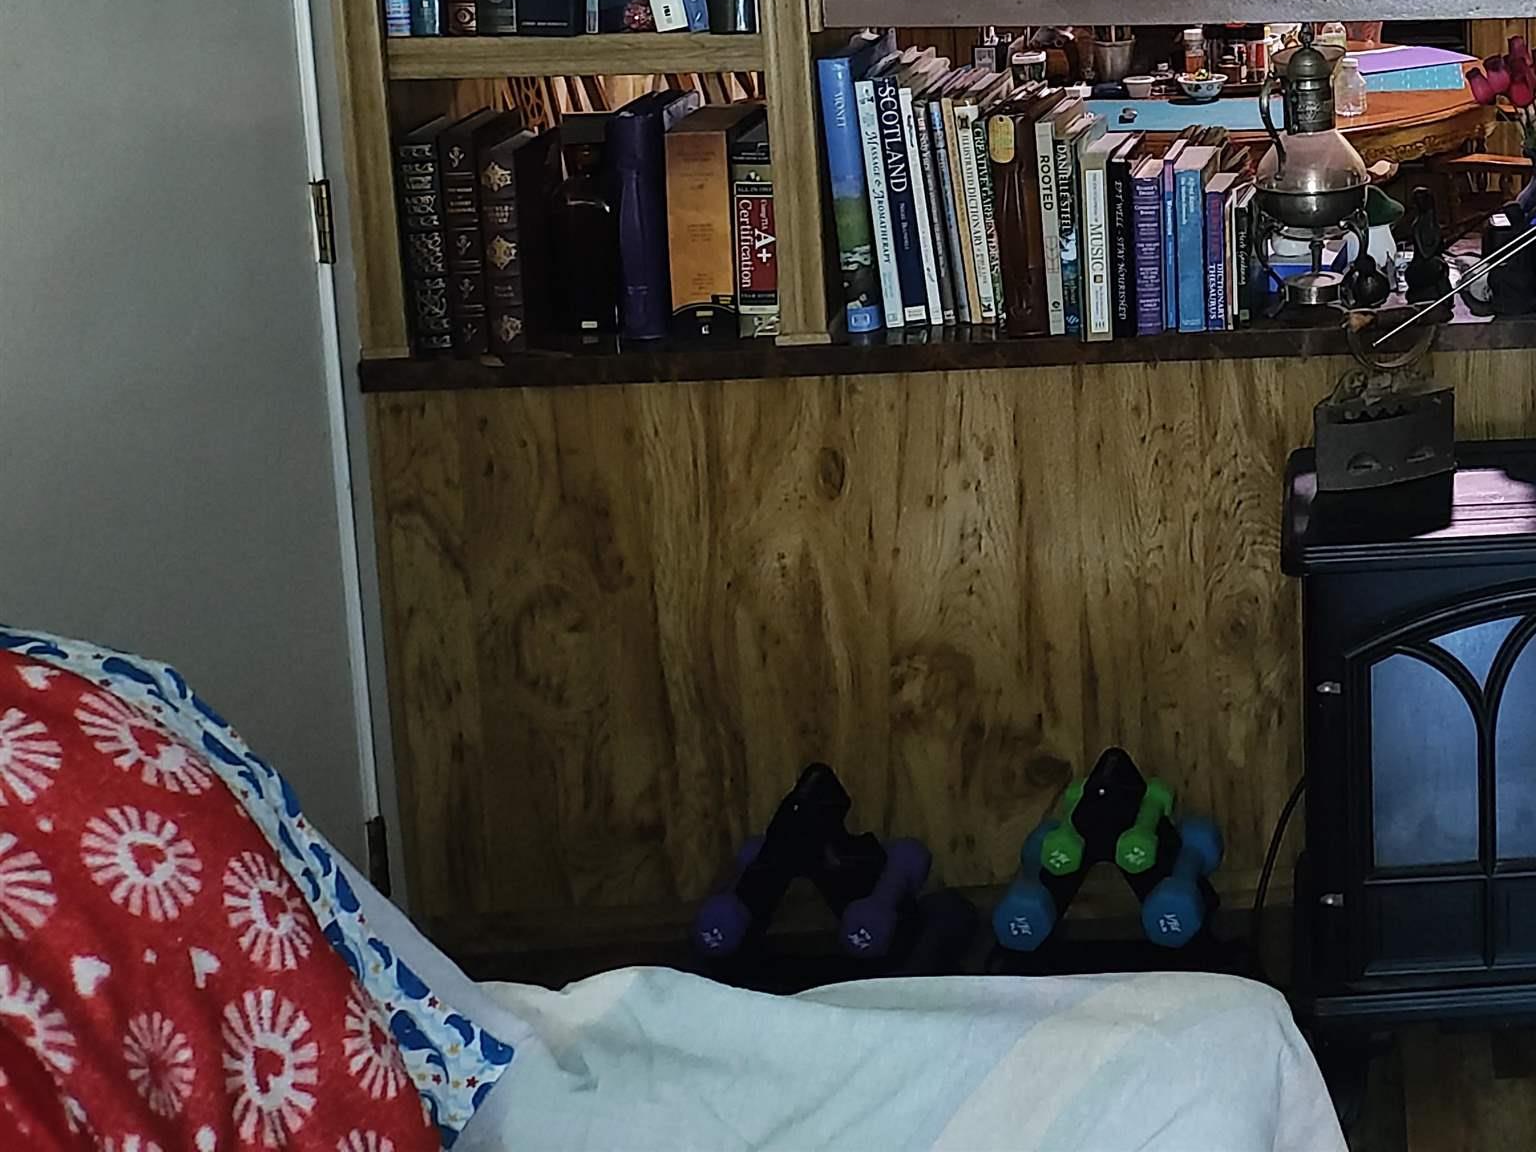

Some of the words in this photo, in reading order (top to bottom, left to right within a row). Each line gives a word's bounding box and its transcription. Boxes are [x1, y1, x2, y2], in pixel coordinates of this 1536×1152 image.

[834, 91, 846, 128] MONET
[865, 131, 880, 176] MASSAGE
[878, 86, 907, 193] SCOTLAND
[961, 134, 974, 186] ILLUSTRATED
[1040, 155, 1053, 211] ROOTED
[1056, 145, 1069, 198] DANIELLE
[759, 199, 768, 230] CompTIA
[872, 188, 891, 264] AROMATHERAPY
[967, 187, 982, 247] DICTIONARY
[973, 127, 987, 185] CREATIVE
[980, 187, 994, 235] GARDEN
[987, 238, 1000, 274] IDEAS
[1061, 200, 1072, 231] STEEL
[1115, 203, 1124, 228] WELL
[738, 200, 754, 288] Certification
[755, 229, 776, 263] A+
[1089, 223, 1104, 272] MUSIC
[1117, 237, 1125, 260] STAY
[1238, 251, 1247, 286] Gardening
[1117, 262, 1127, 320] NOURISHED
[1209, 263, 1217, 319] THESAURUS
[1216, 263, 1224, 320] DICTIONARY
